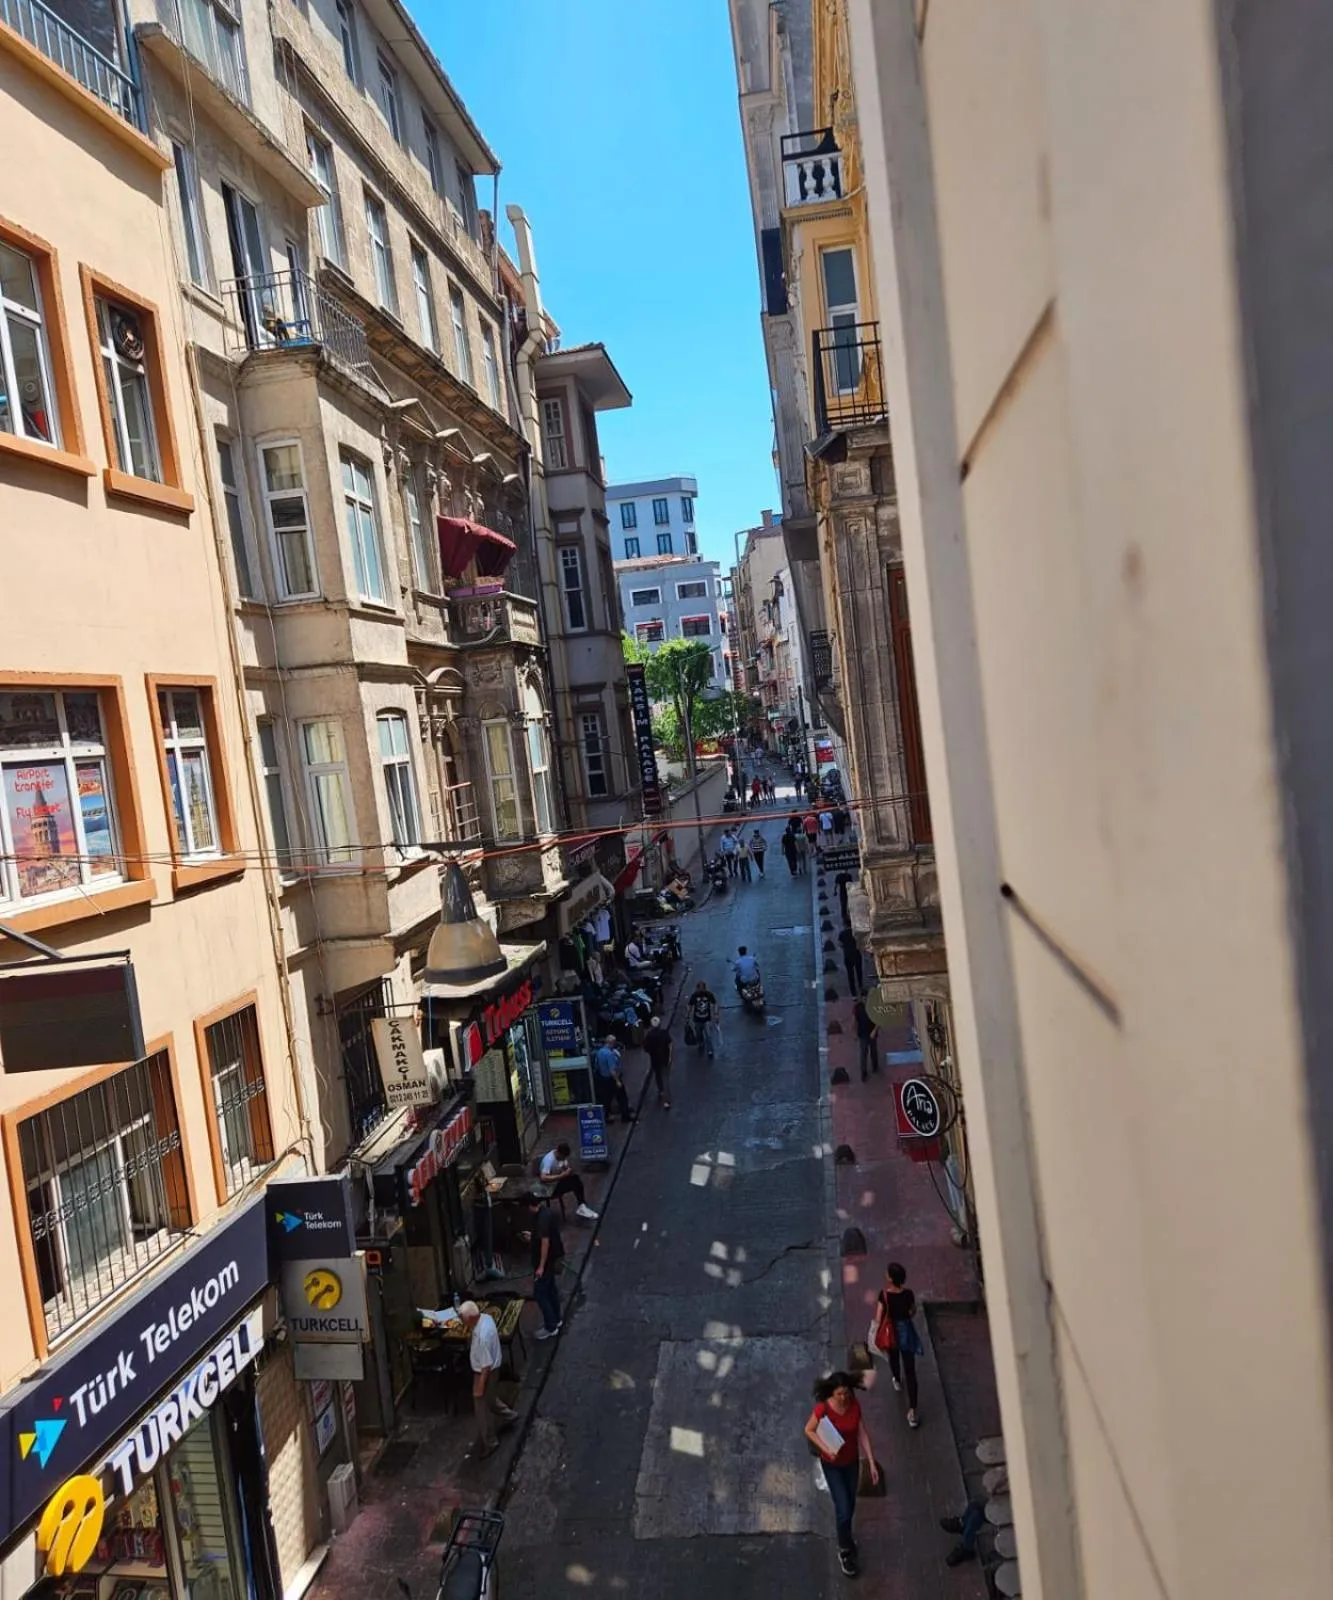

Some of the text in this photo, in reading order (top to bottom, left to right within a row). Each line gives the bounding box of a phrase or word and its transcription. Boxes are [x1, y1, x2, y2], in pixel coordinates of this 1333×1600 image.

[388, 1079, 426, 1092] OSMAN
[303, 1211, 324, 1221] Türk
[304, 1219, 342, 1230] Telekom
[291, 1316, 364, 1332] TURKCELL
[69, 1260, 241, 1429] Türk Telekom
[107, 1316, 265, 1497] TURKCELL
